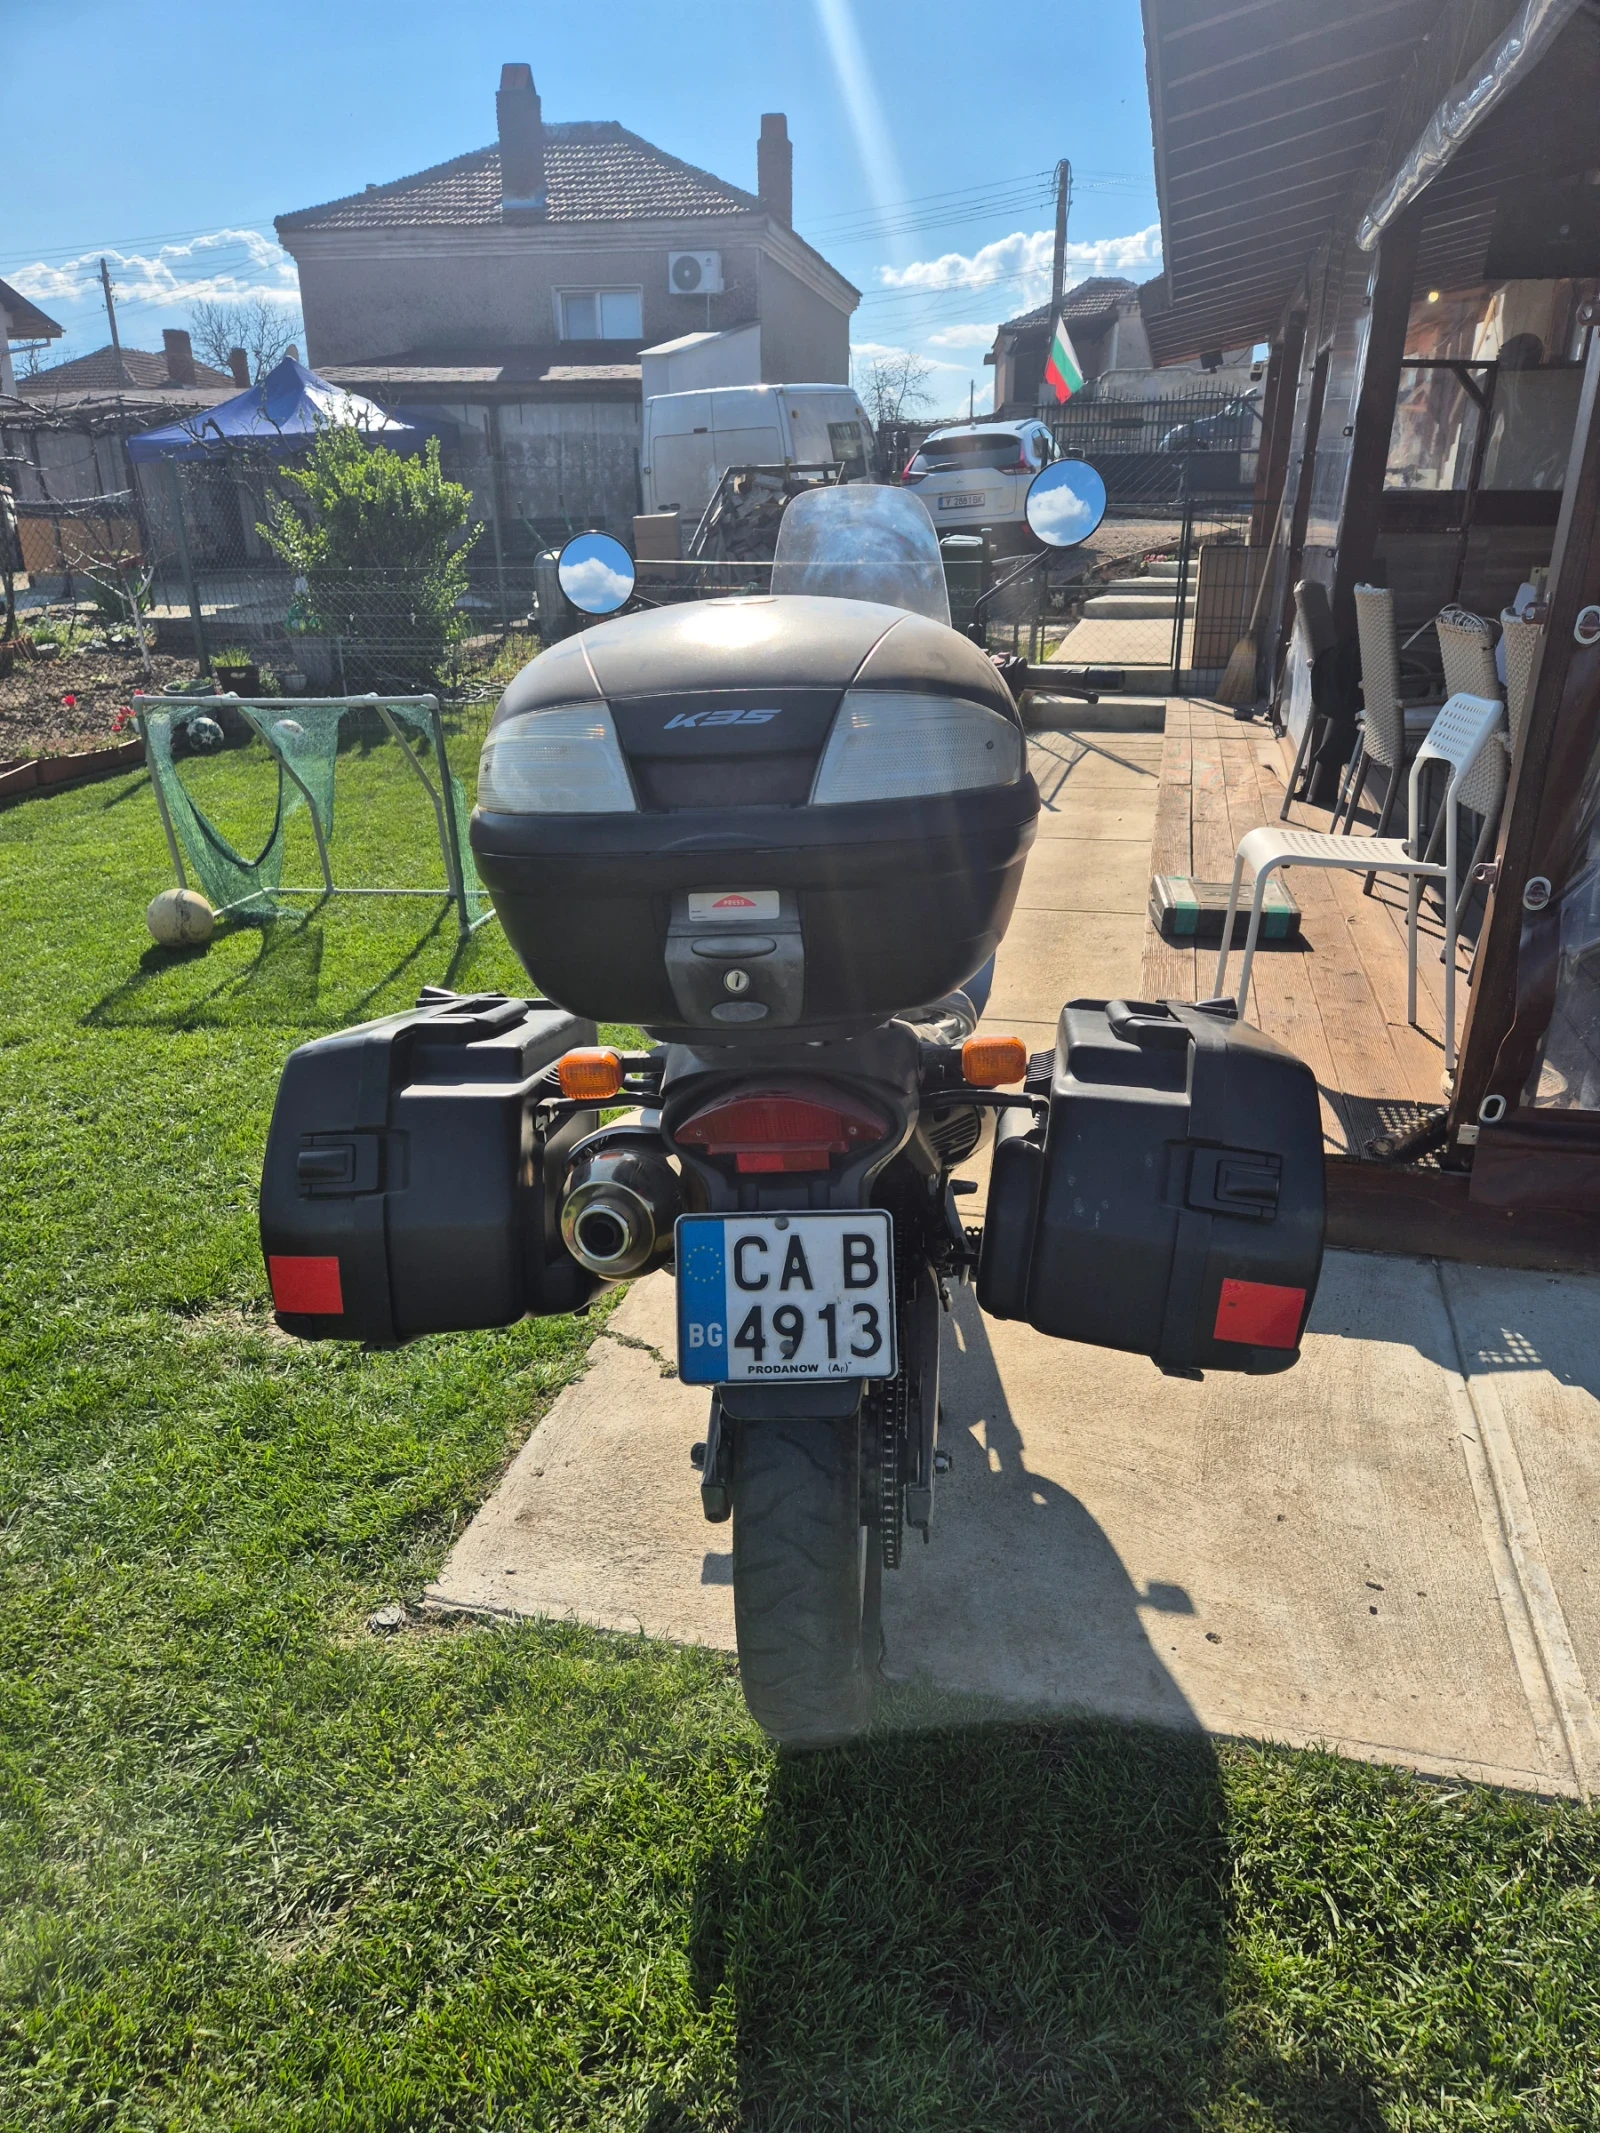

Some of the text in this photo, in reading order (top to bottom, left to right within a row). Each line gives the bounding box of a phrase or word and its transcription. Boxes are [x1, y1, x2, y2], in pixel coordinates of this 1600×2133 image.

[689, 1322, 723, 1348] BG
[733, 1303, 882, 1361] 4913
[747, 1363, 819, 1374] PRODANOW
